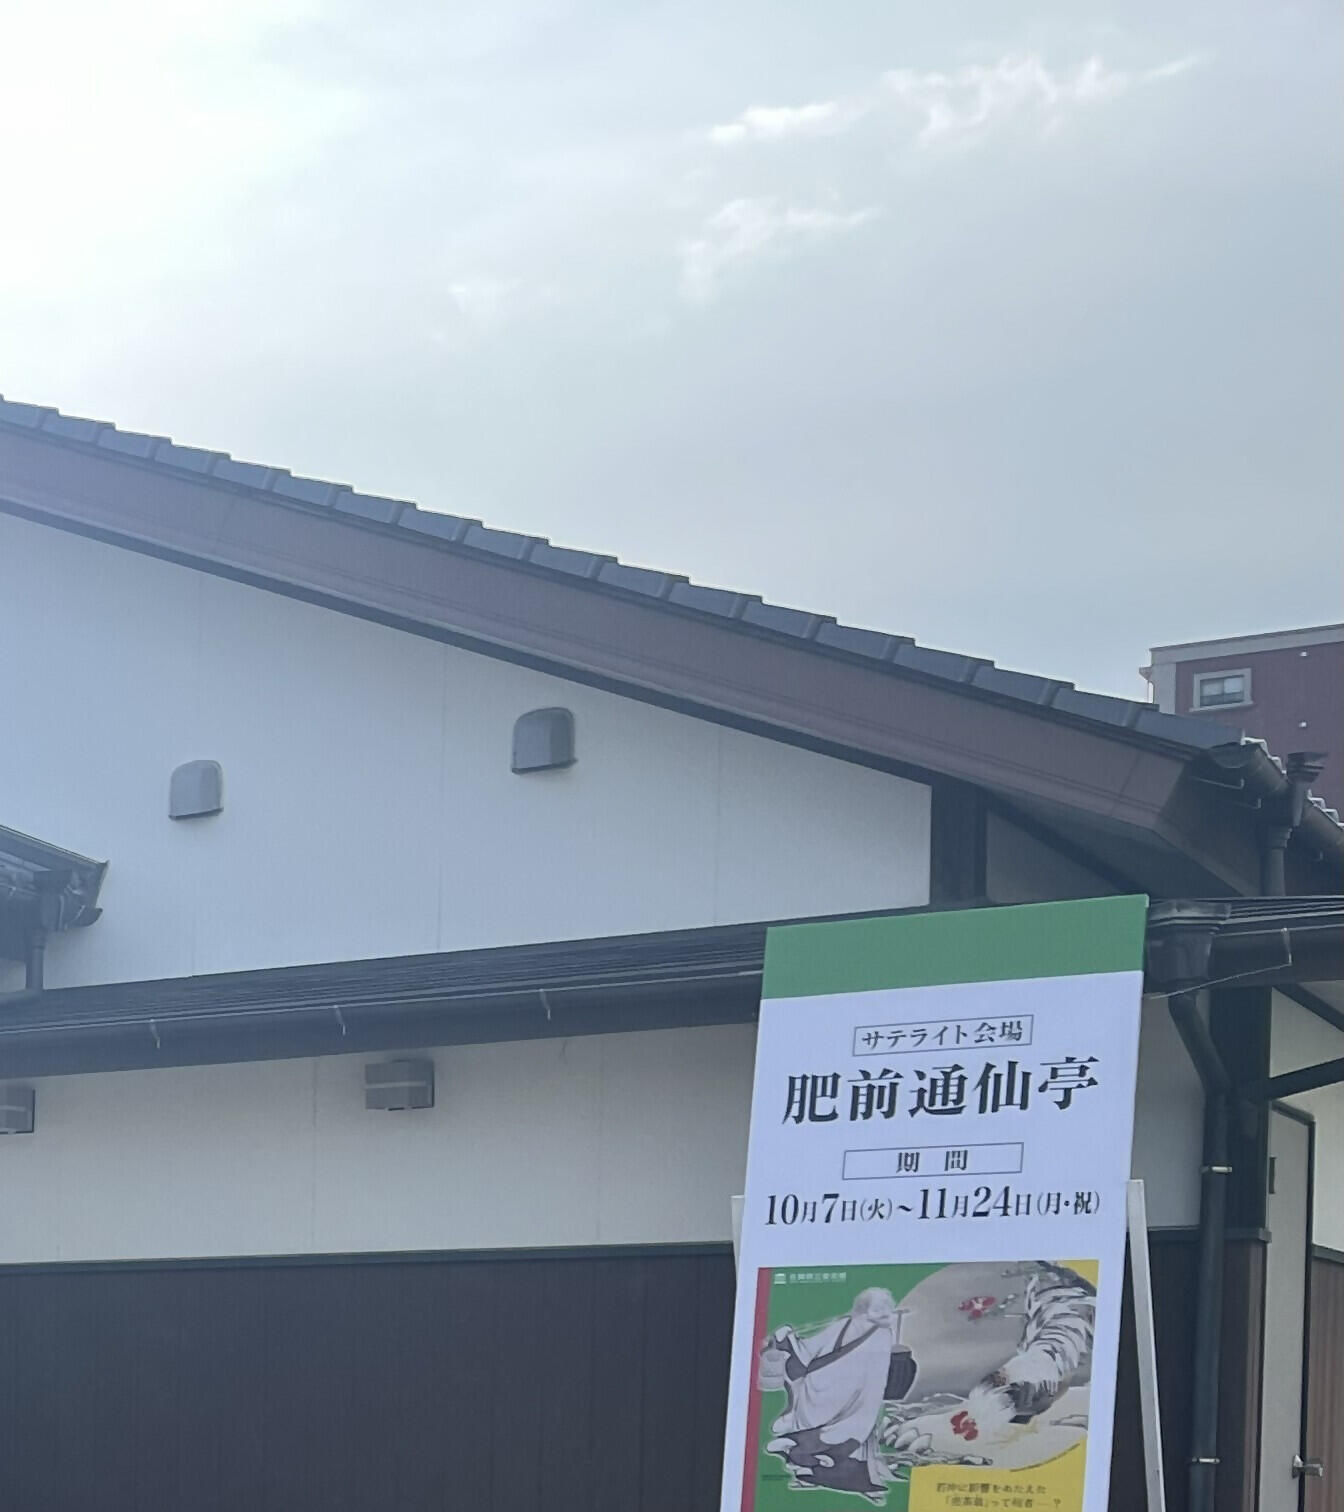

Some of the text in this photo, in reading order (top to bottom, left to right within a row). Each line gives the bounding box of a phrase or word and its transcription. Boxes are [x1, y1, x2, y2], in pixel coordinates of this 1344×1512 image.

[861, 1022, 1022, 1050] サテライト会場
[782, 1055, 1101, 1125] 肥前通仙亭
[895, 1149, 969, 1174] 期間
